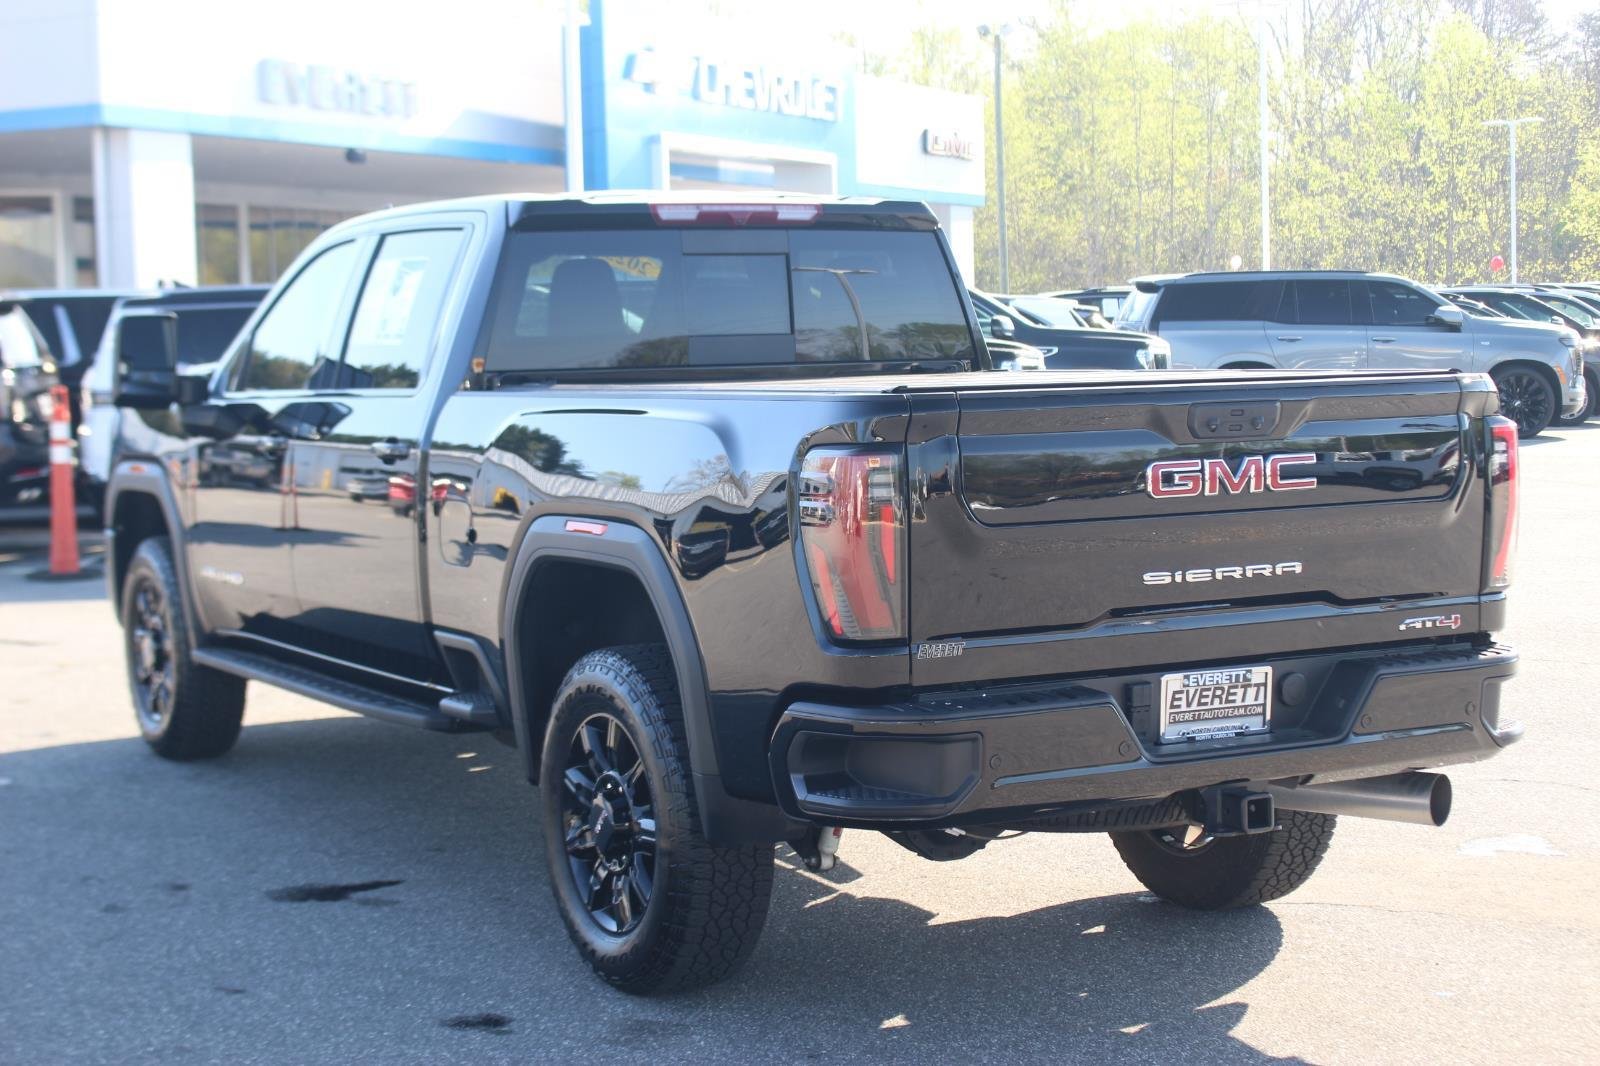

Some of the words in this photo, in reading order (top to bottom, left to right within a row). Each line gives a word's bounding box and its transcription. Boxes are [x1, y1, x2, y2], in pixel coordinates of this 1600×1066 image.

[1146, 453, 1317, 499] GMC
[1142, 561, 1303, 585] SIERRA
[1398, 614, 1461, 632] AT4
[917, 641, 966, 660] EVERETT
[1188, 671, 1245, 687] EVERETT
[1169, 683, 1265, 709] EVERETT
[1169, 705, 1263, 723] EVERETTAUTOTEAM.COM
